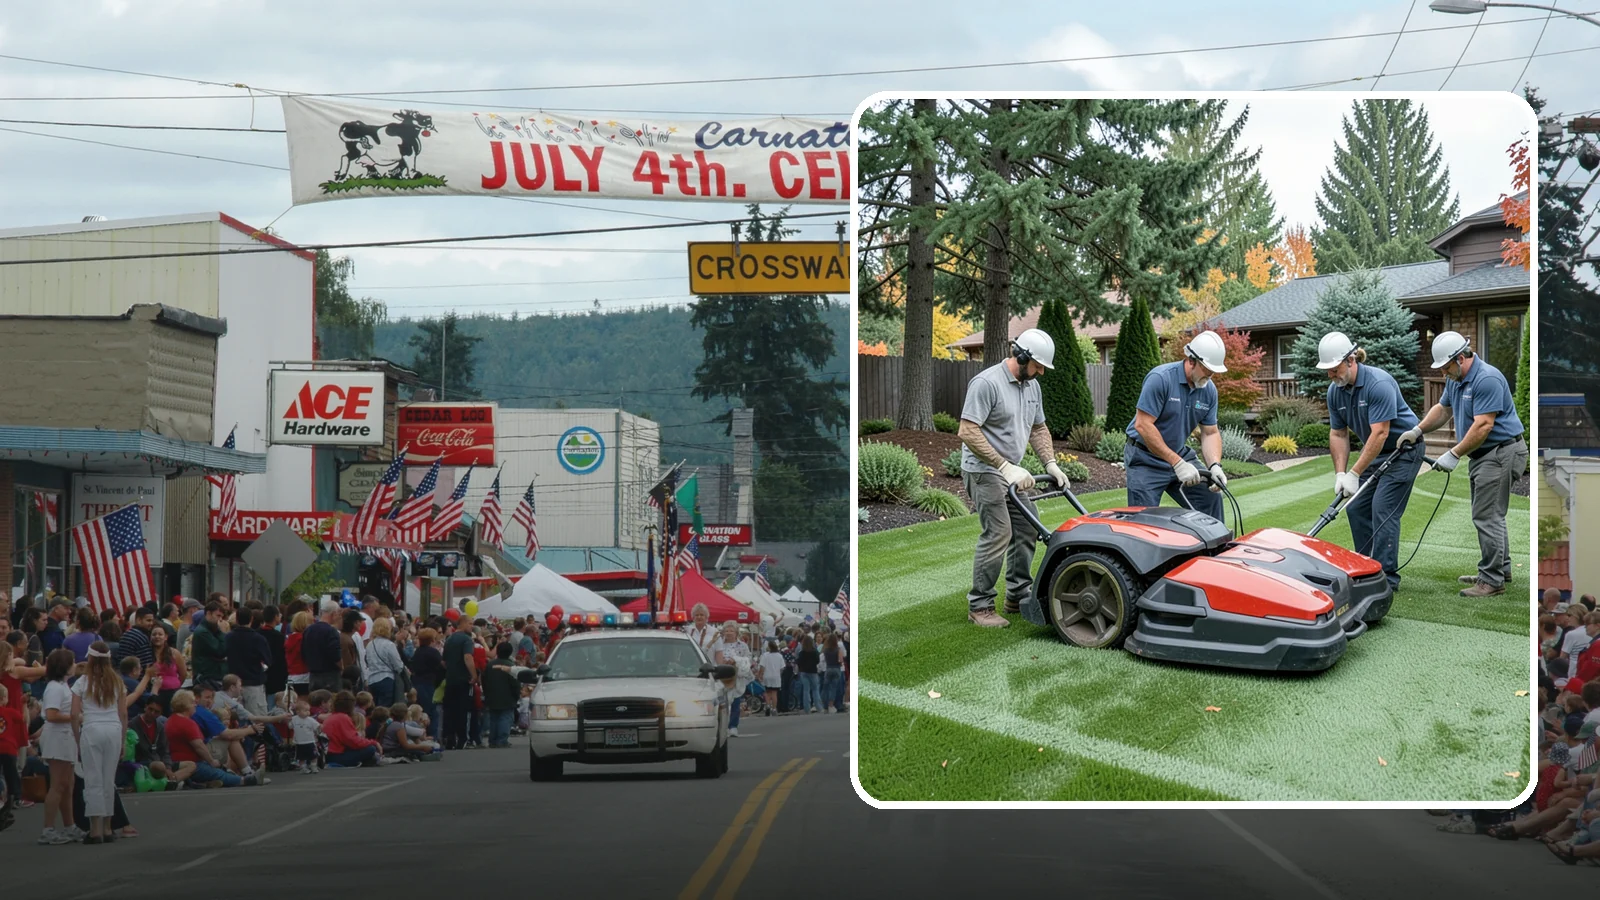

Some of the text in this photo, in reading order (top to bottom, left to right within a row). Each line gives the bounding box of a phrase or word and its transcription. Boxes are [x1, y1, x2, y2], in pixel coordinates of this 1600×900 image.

[481, 140, 605, 192] JULY
[632, 150, 746, 198] 4th.
[697, 254, 850, 280] CROSSWA
[283, 380, 373, 420] ACE
[405, 409, 452, 422] CEDAR
[283, 421, 371, 436] Hardware
[416, 428, 477, 447] Coca-Cola
[353, 467, 386, 480] Simpl
[95, 485, 124, 495] Vincent
[126, 486, 136, 494] de
[138, 486, 155, 495] Paul
[688, 526, 741, 535] CRNATION
[699, 535, 730, 543] GLASS
